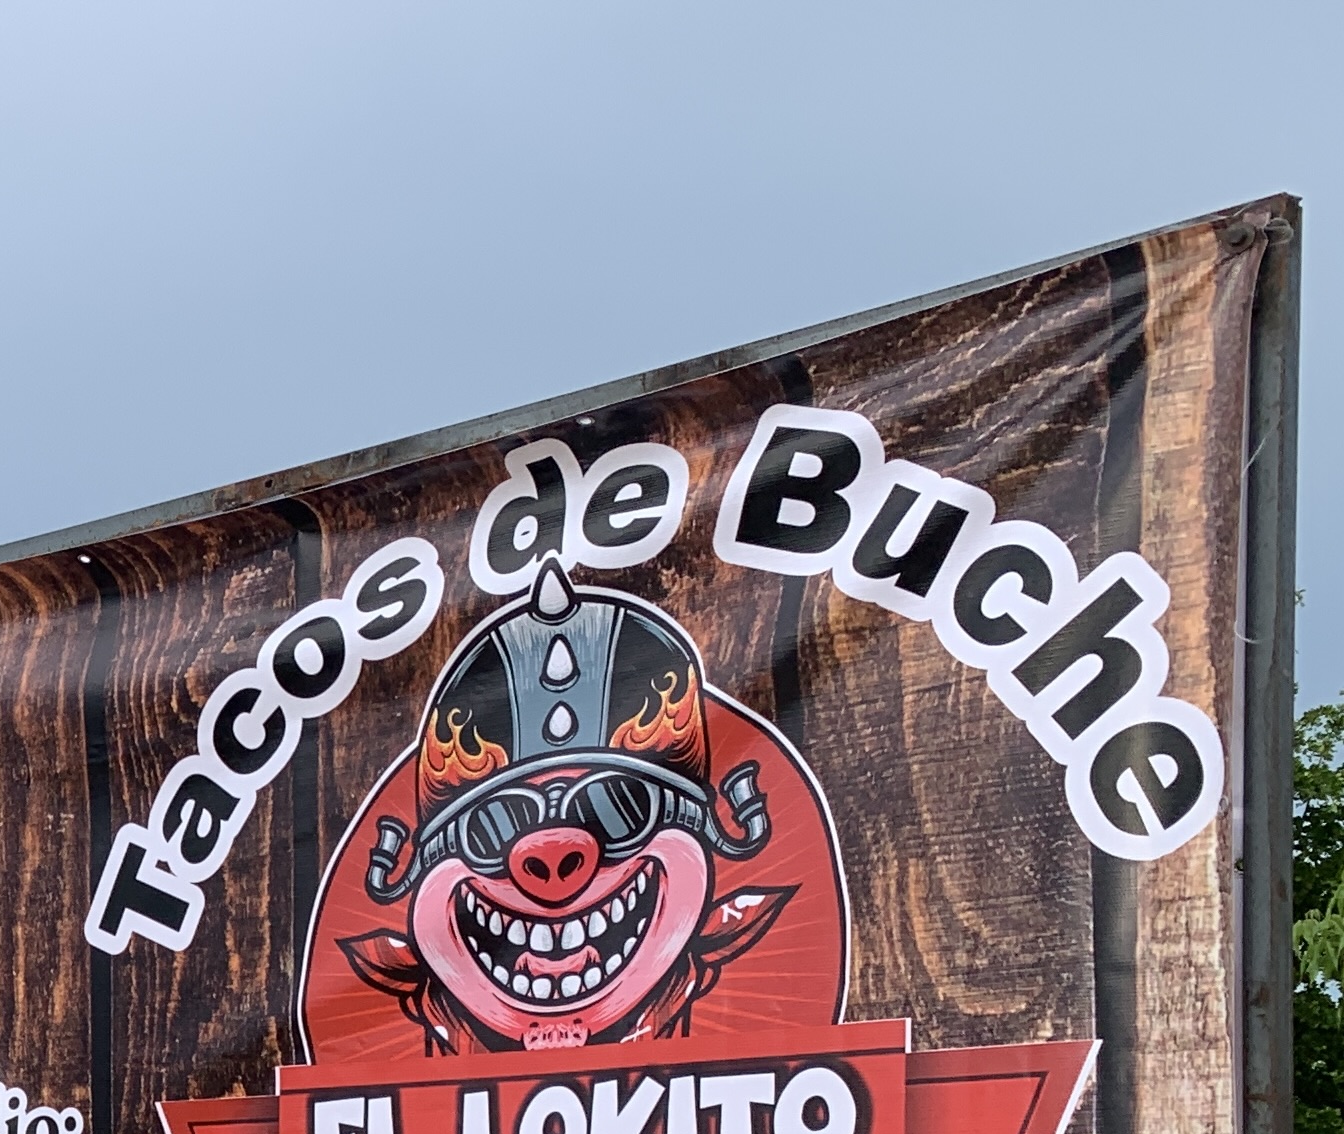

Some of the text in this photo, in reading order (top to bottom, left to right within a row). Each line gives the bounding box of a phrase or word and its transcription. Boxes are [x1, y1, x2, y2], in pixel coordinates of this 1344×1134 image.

[92, 414, 1214, 946] Tacos de Buche
